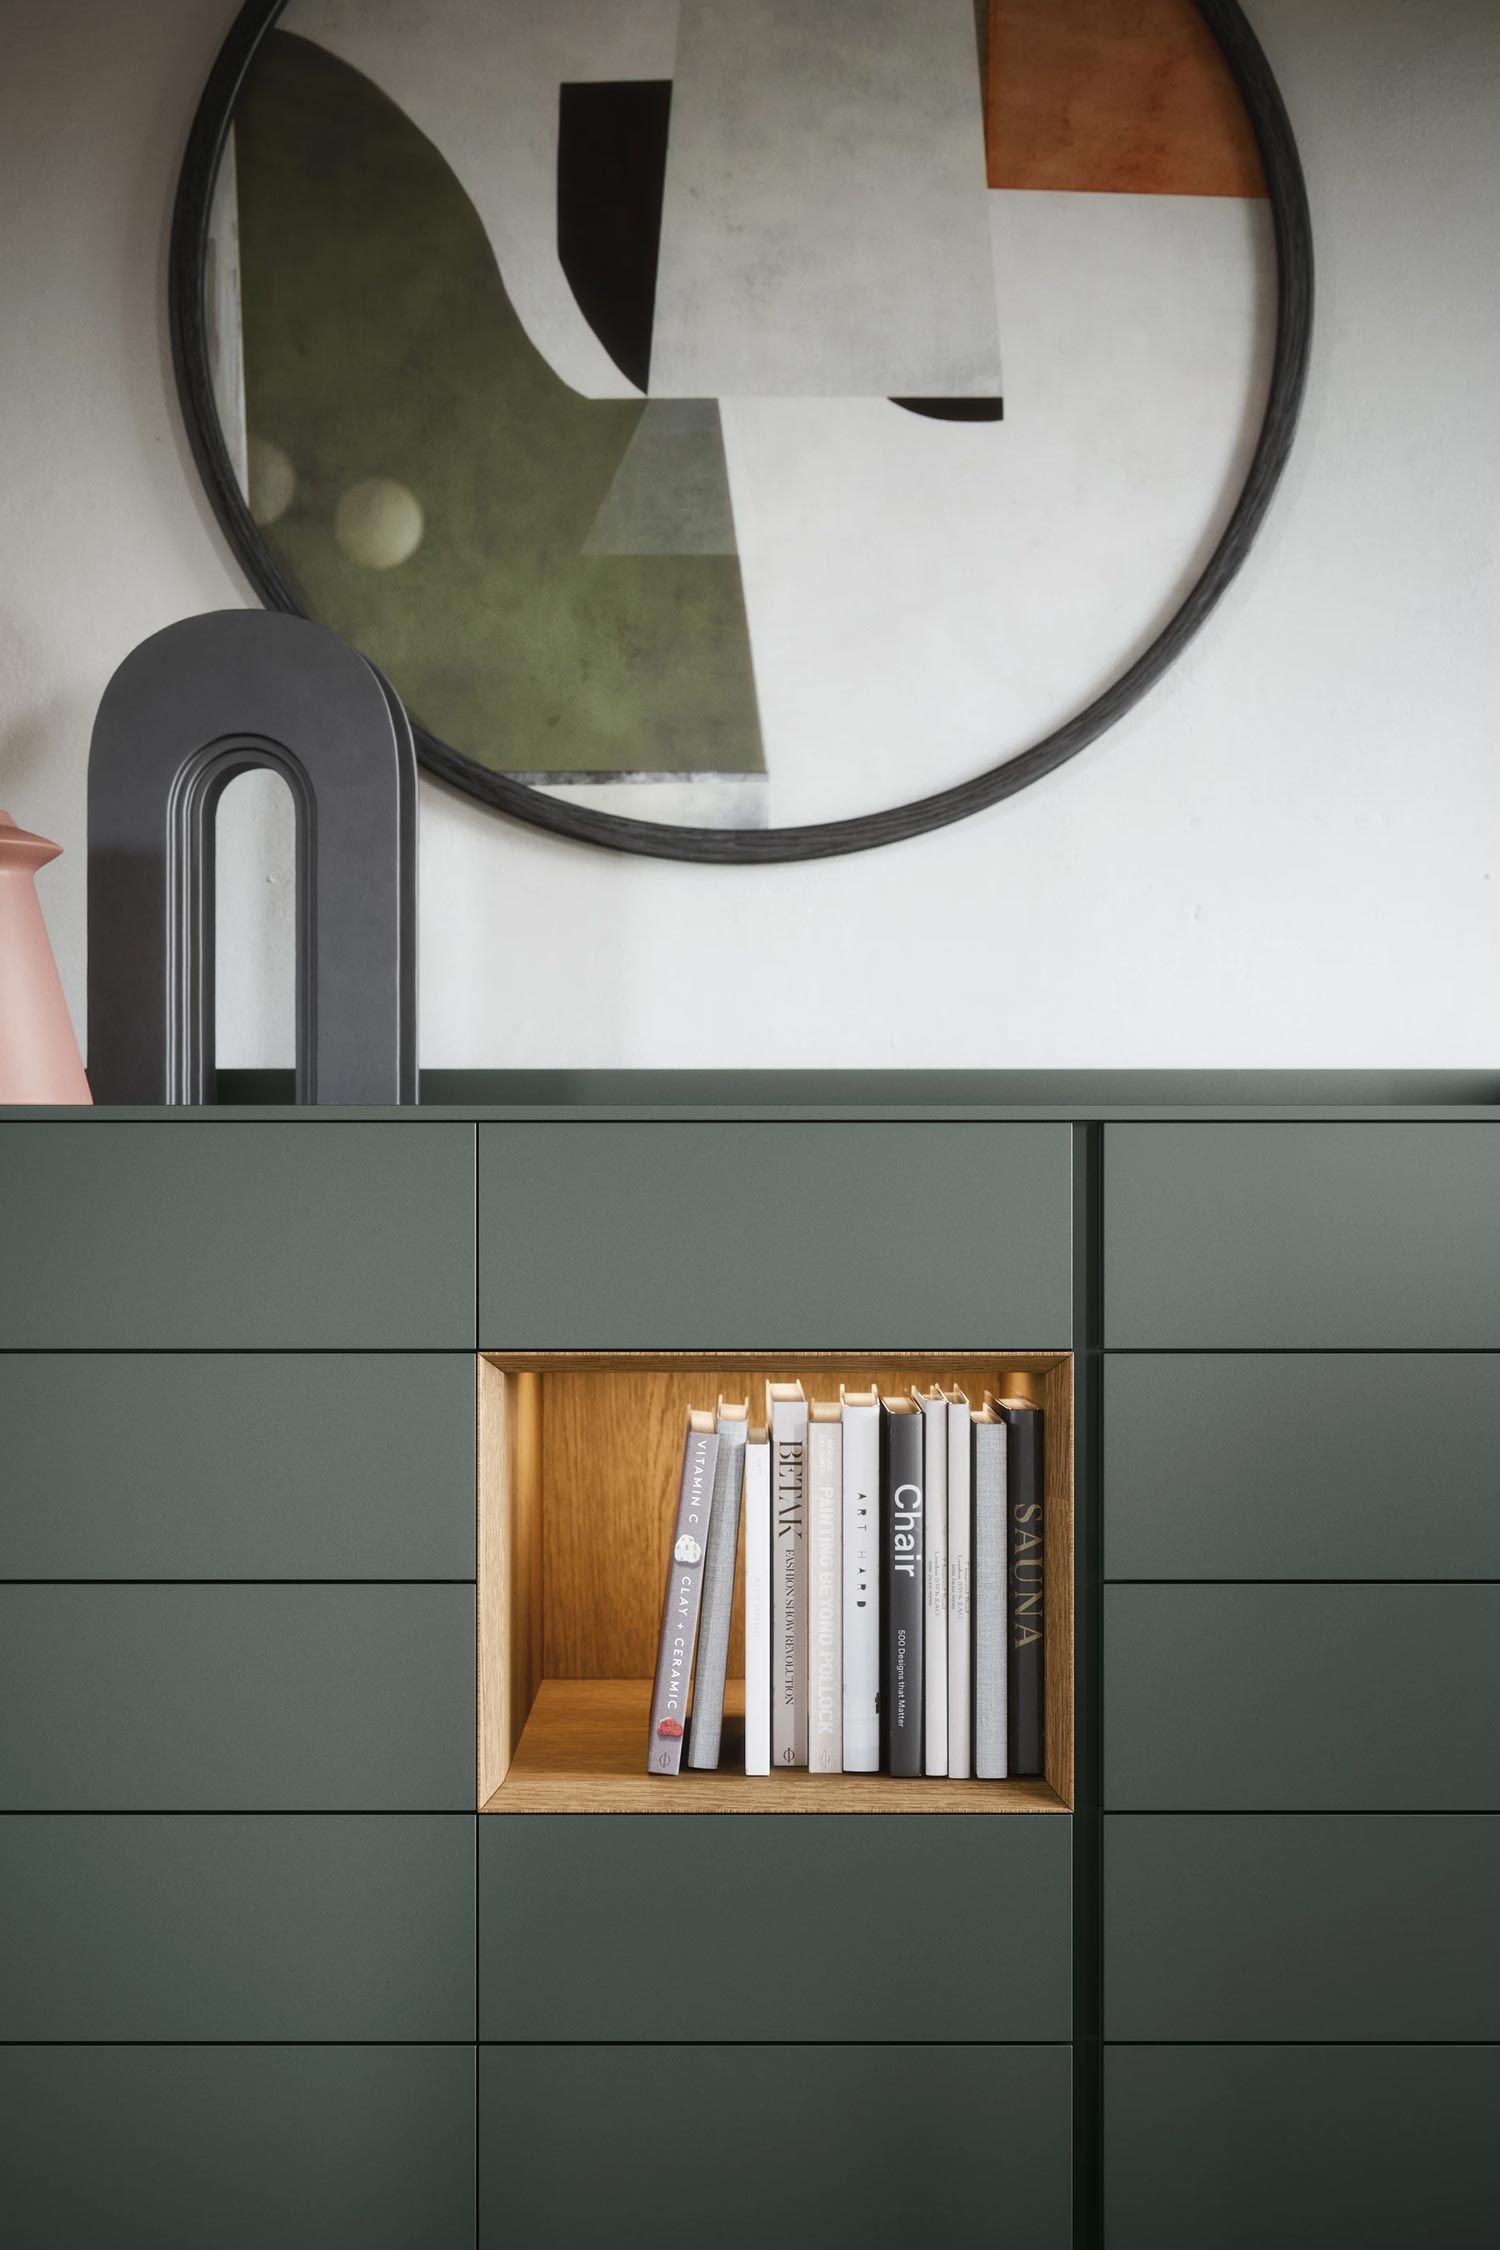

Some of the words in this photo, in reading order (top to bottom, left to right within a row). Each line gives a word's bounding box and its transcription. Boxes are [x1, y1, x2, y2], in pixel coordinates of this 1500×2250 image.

[689, 1440, 708, 1507] VITAMIN
[779, 1441, 803, 1538] BETAK
[688, 1513, 698, 1524] C
[819, 1487, 834, 1567] PAINTING
[857, 1492, 867, 1531] ART
[894, 1484, 922, 1577] Chair
[679, 1576, 691, 1617] CLAY
[785, 1550, 795, 1597] FASHION
[857, 1550, 867, 1607] HARD
[1014, 1503, 1042, 1649] SAUNA
[785, 1600, 795, 1634] SHOW
[818, 1572, 834, 1646] BEYOND
[898, 1629, 906, 1646] 500
[667, 1637, 685, 1710] CERAMIC
[785, 1635, 795, 1705] REVOLUTION
[896, 1648, 906, 1680] Designs
[898, 1681, 906, 1698] that
[818, 1652, 834, 1734] POLLOCK
[898, 1699, 906, 1728] Matter
